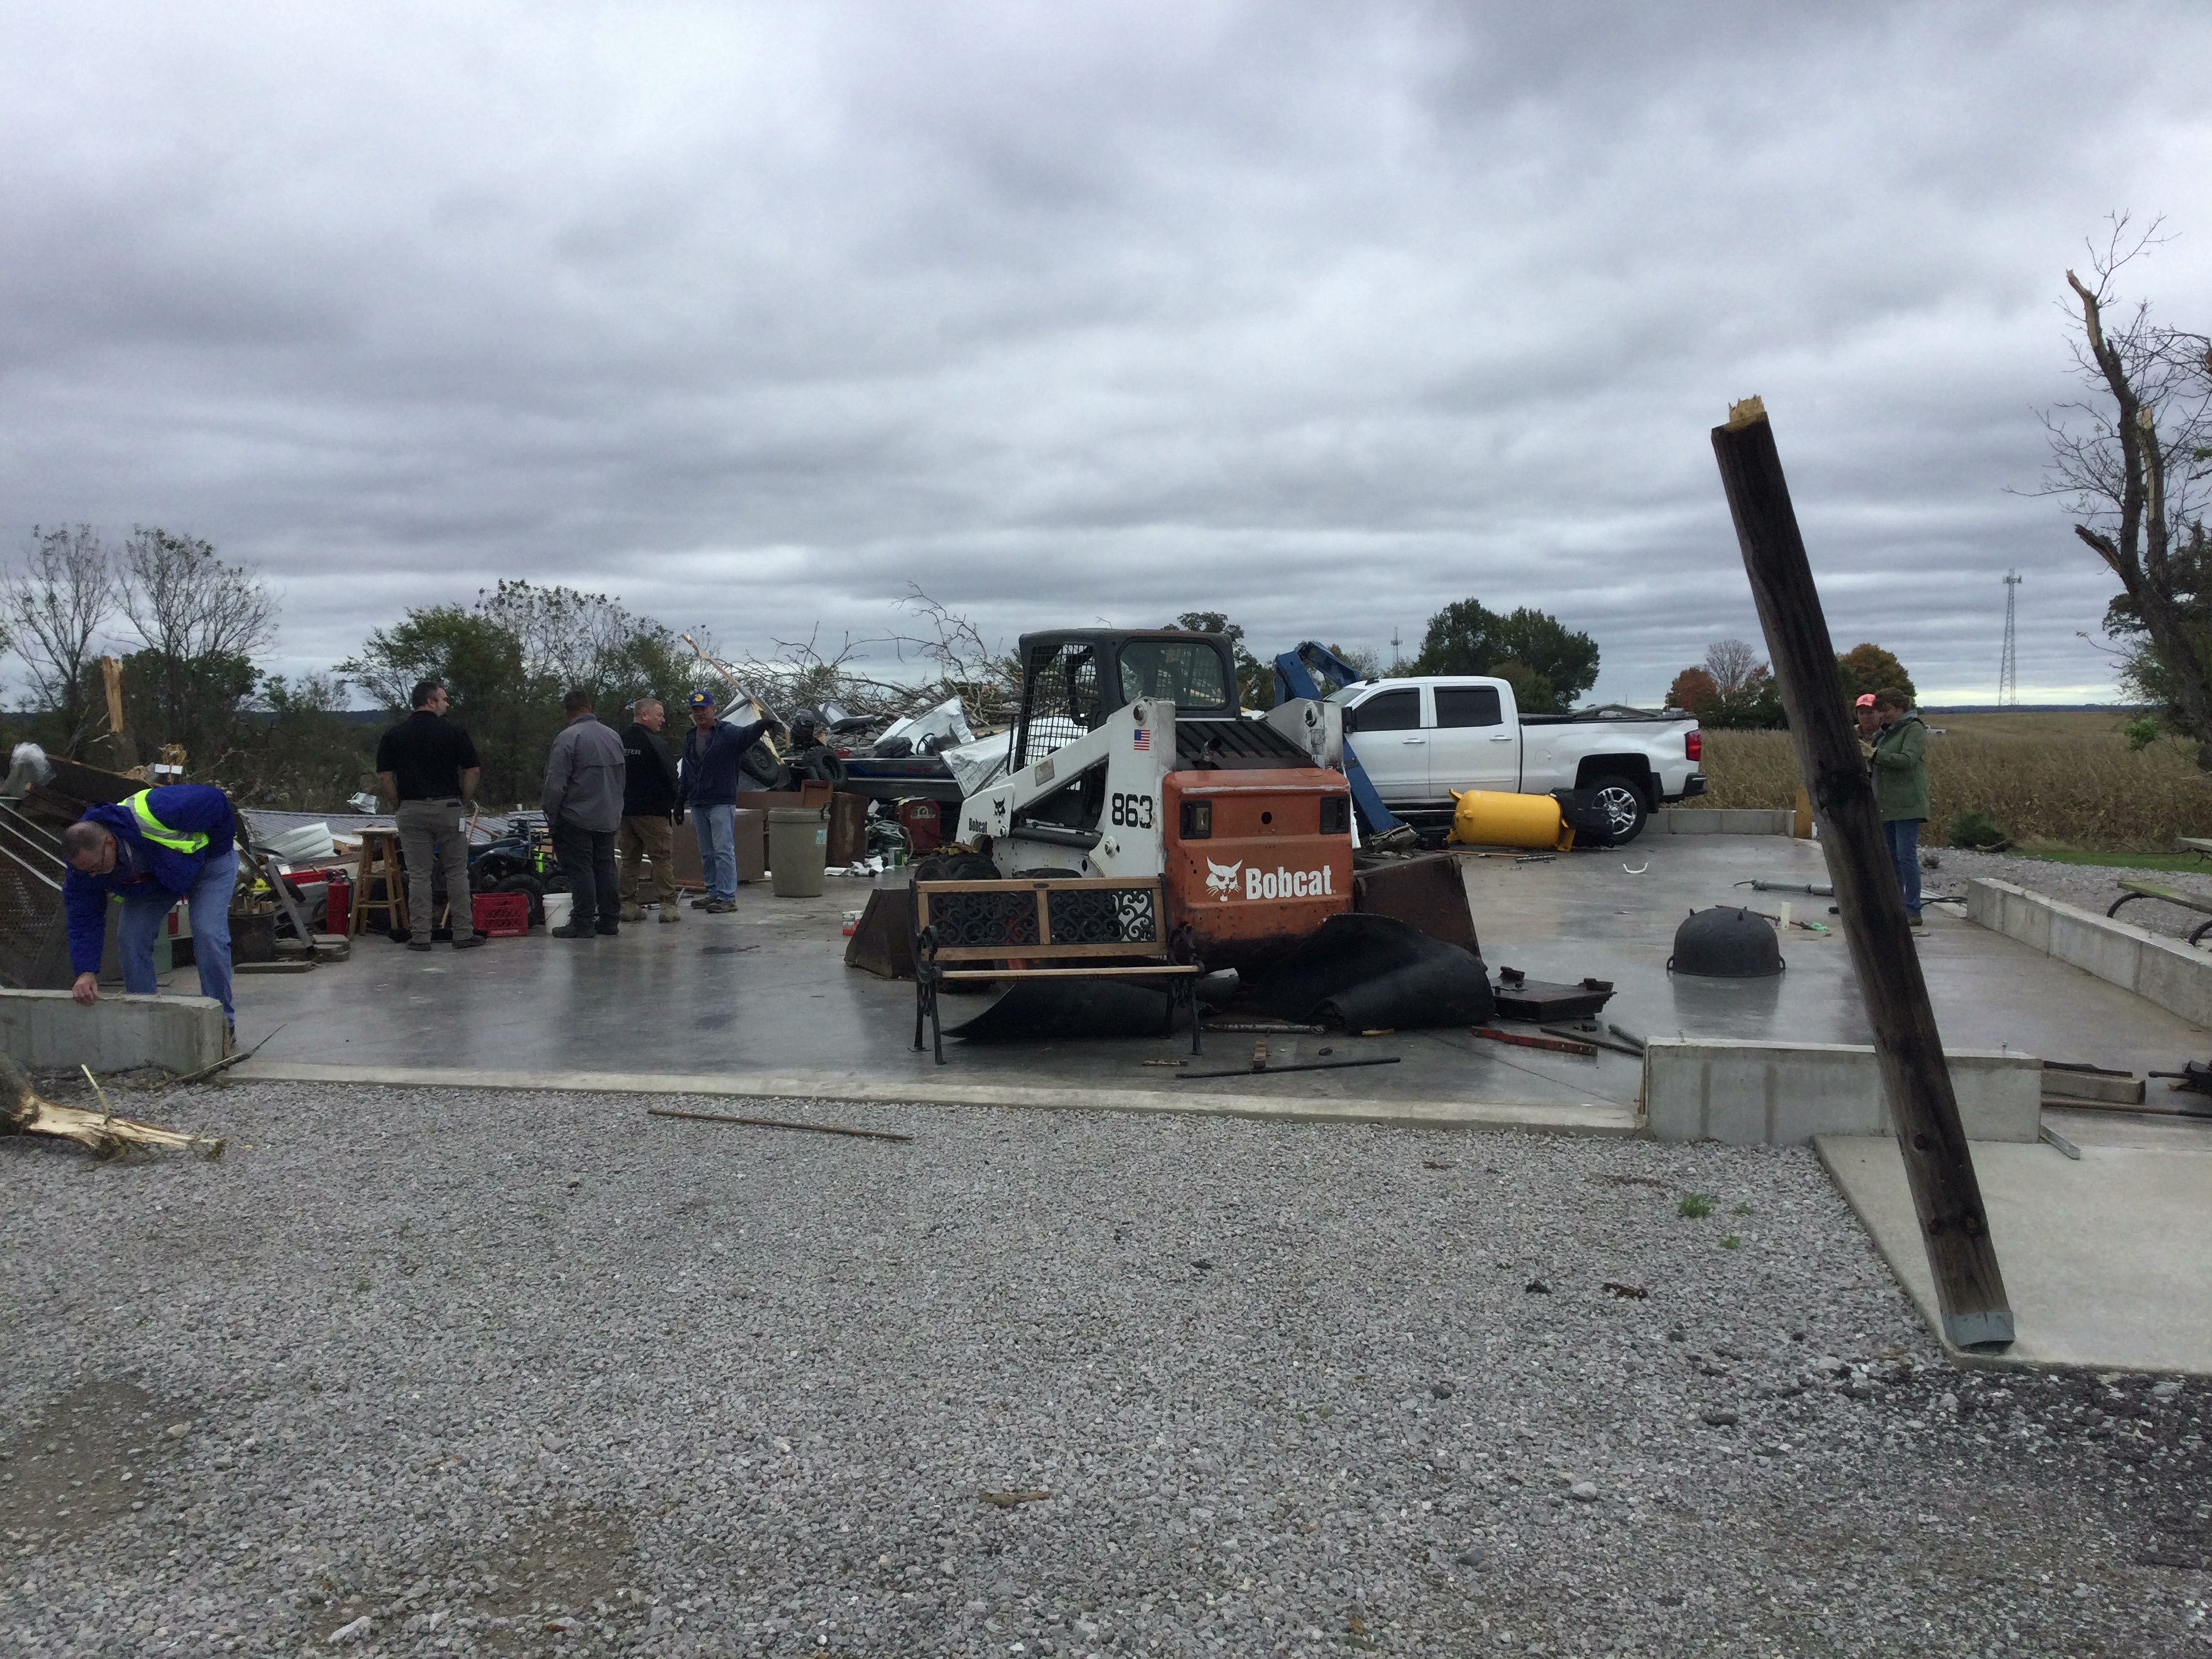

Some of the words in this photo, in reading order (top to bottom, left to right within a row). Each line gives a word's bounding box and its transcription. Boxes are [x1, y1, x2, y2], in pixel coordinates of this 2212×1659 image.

[968, 817, 987, 834] Bobcat
[1112, 793, 1153, 829] 863
[1246, 865, 1332, 900] Bobcat
